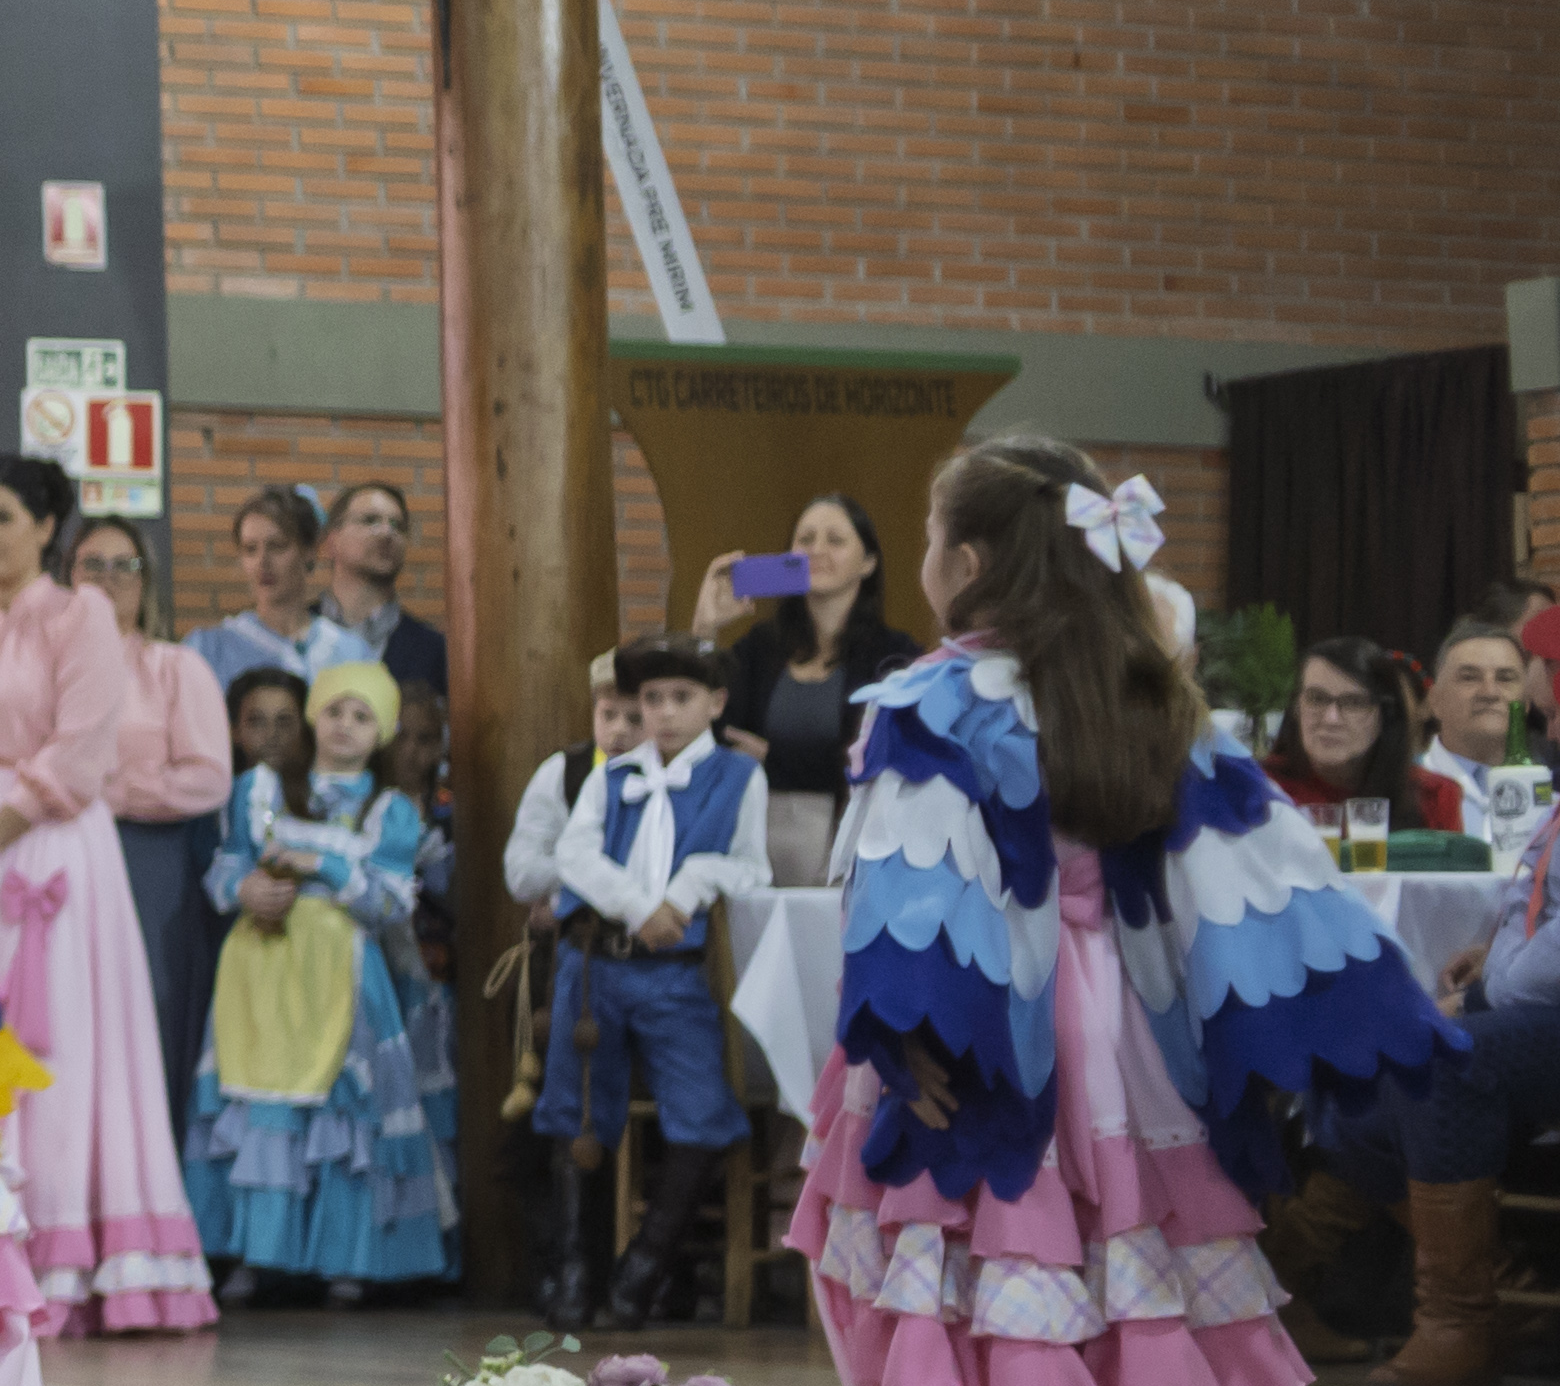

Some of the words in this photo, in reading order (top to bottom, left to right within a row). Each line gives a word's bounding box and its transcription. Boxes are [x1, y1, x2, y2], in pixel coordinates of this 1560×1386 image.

[659, 239, 694, 312] MIRIM
[629, 368, 670, 410] CTG
[674, 369, 810, 414] CARRETEIROS
[814, 373, 840, 414] DE
[843, 376, 956, 418] HORIZONTE
